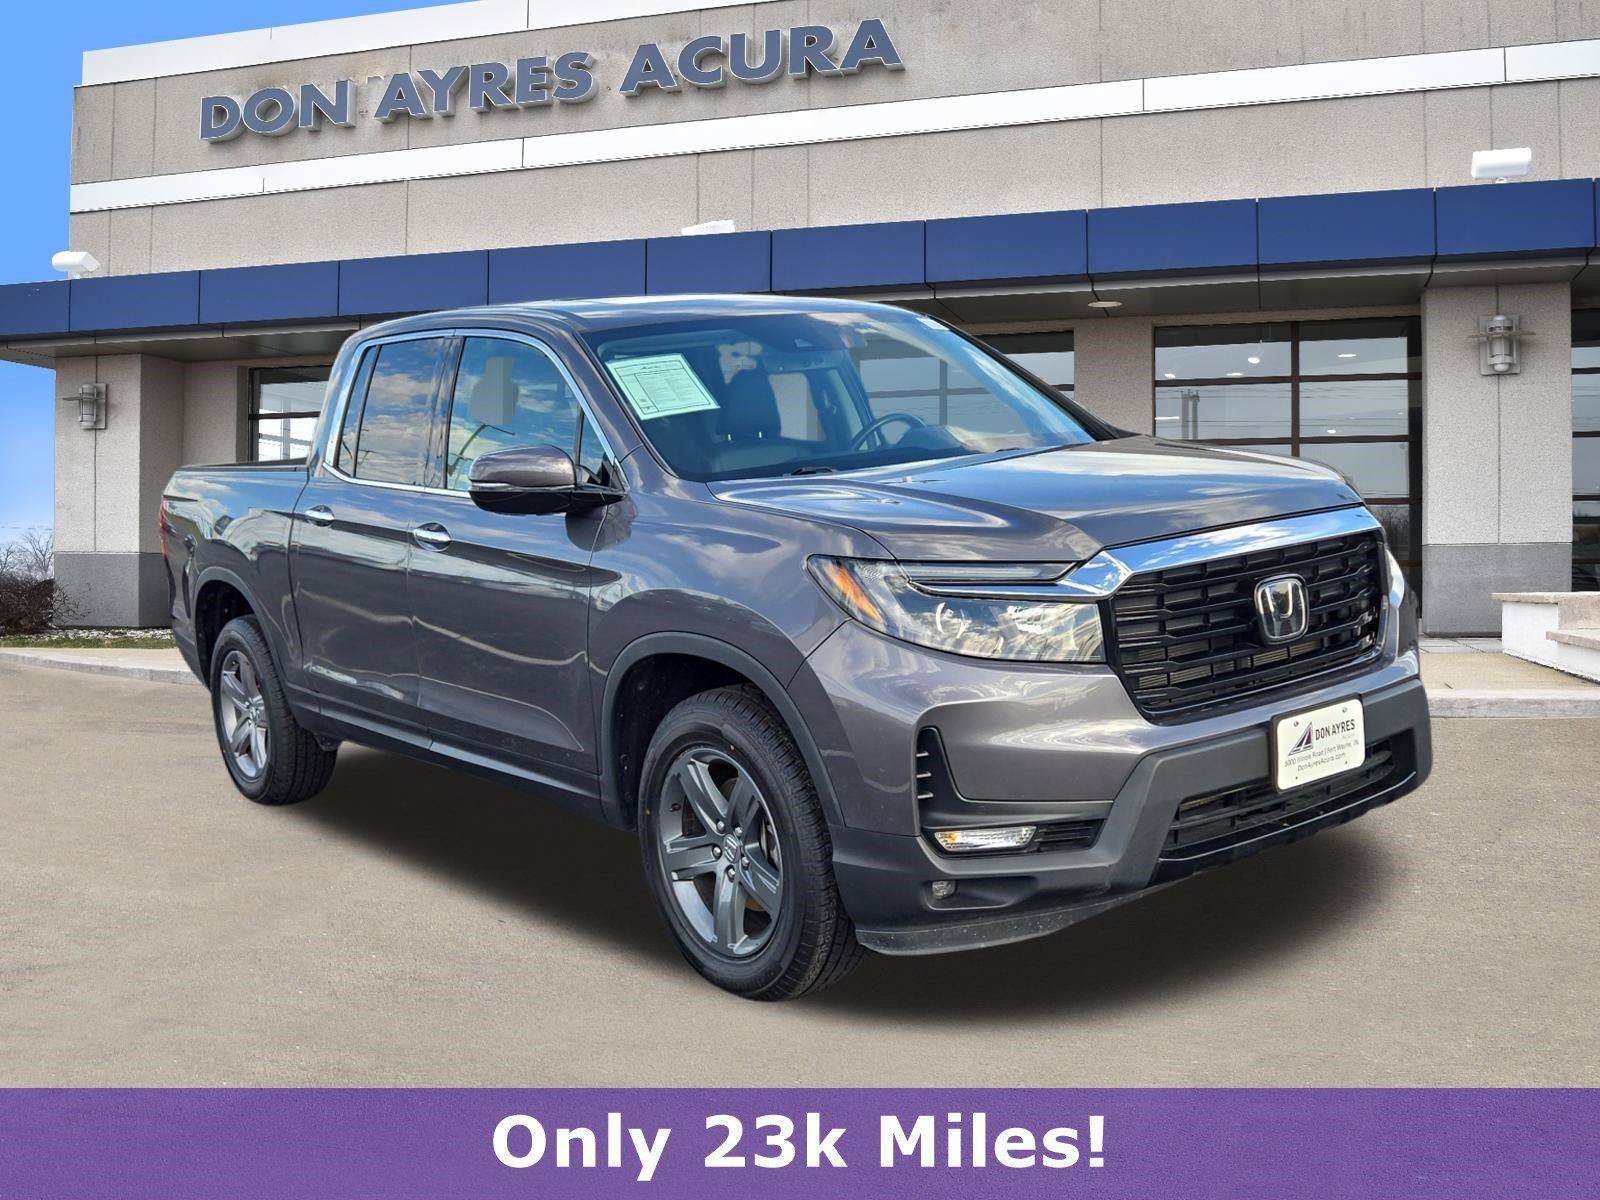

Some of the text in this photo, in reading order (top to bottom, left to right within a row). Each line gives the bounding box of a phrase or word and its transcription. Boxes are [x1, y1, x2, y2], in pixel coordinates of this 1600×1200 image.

[200, 17, 905, 144] DON AYRES ACURA
[1315, 725, 1331, 740] DON
[1332, 718, 1355, 735] AYRES
